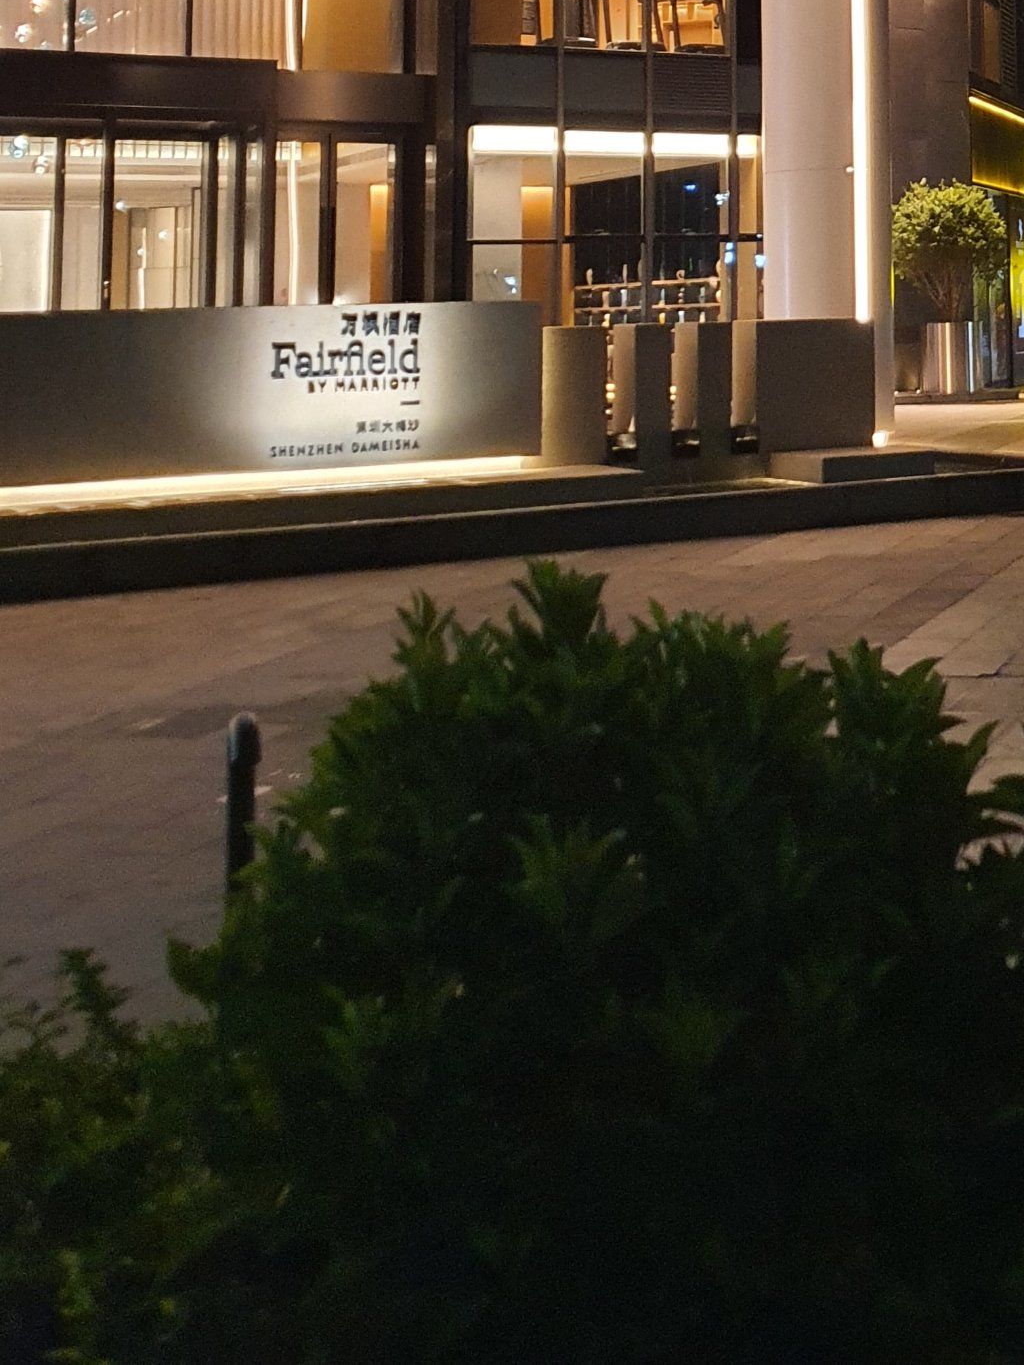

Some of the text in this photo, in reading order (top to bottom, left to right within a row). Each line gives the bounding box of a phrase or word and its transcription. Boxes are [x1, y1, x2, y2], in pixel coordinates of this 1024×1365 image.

[270, 338, 421, 379] Fairfield
[307, 376, 420, 394] BY MARRIOTT
[270, 439, 420, 458] SHENZHEN DAMEISHA
